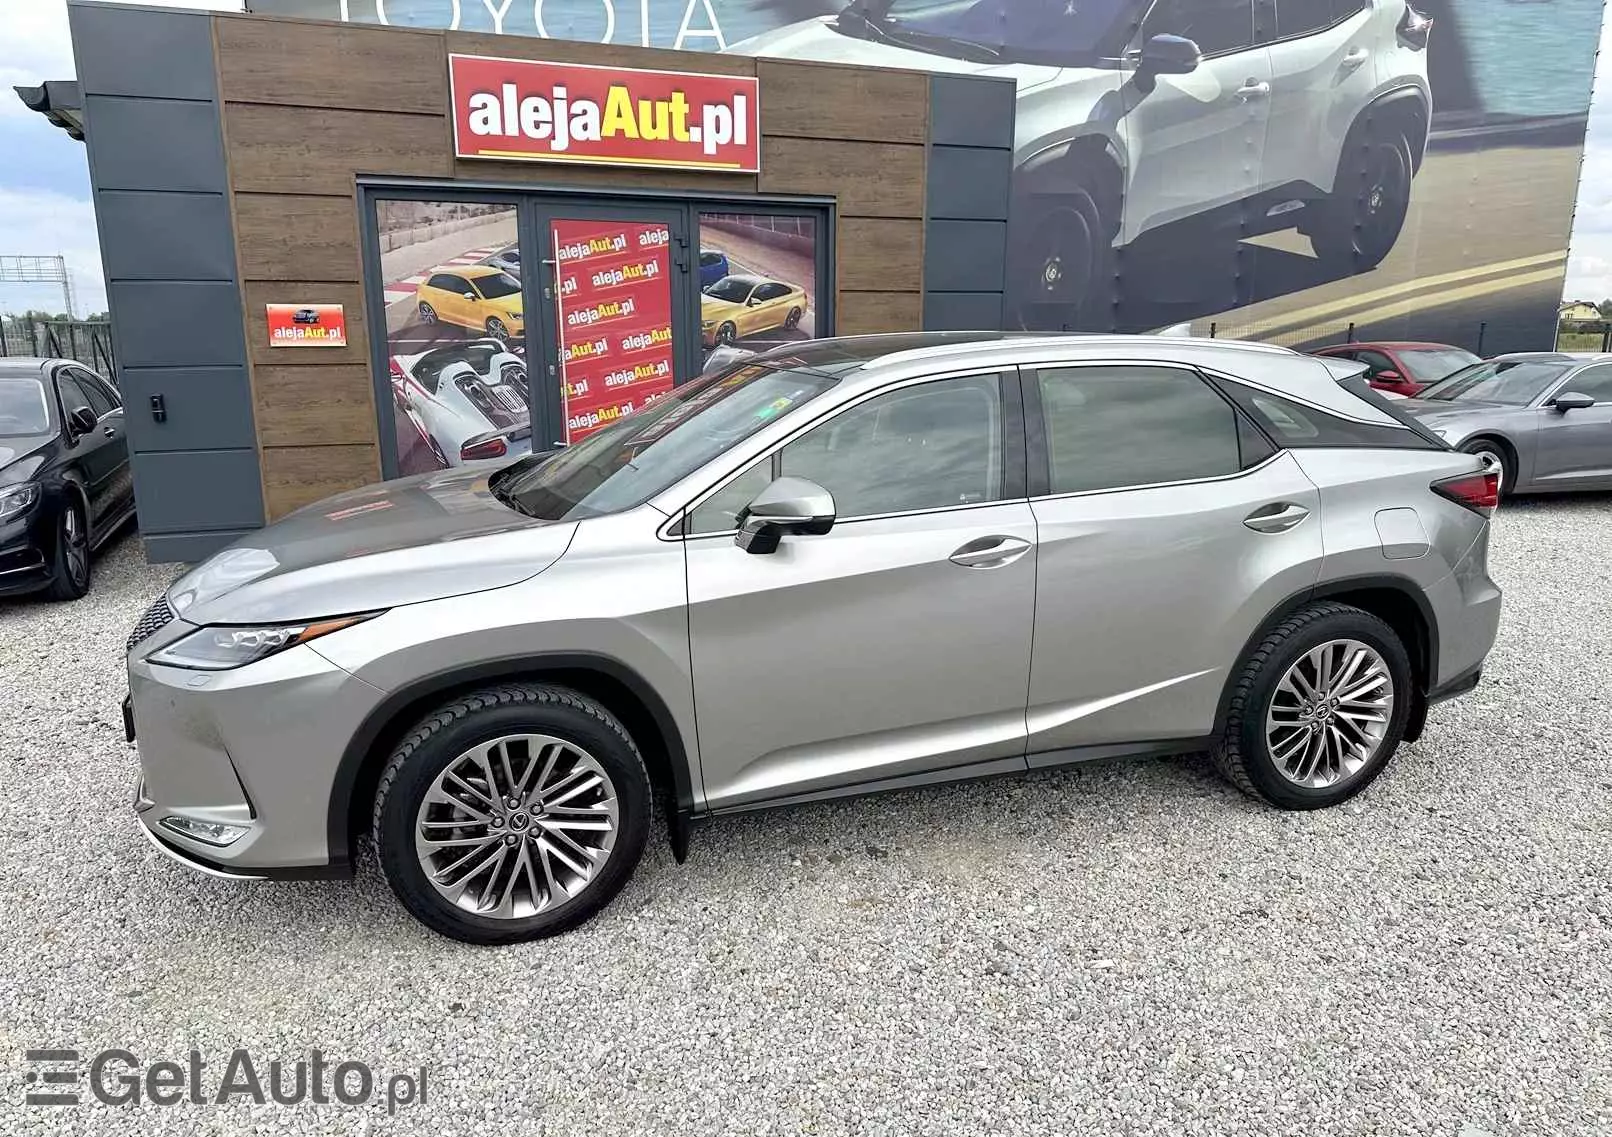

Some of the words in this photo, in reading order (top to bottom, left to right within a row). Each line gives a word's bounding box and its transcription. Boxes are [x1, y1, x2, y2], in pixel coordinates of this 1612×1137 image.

[339, 0, 728, 51] OYOA
[468, 83, 747, 155] alejaAut.pl
[559, 234, 627, 259] alejaAut.pl
[592, 260, 659, 286] alejaAut.pl
[567, 298, 635, 325] alejaAut.pl
[274, 326, 341, 340] alejaAut.pl
[604, 359, 669, 386] alejaAut.pl
[568, 401, 634, 429] alejaAut.pl
